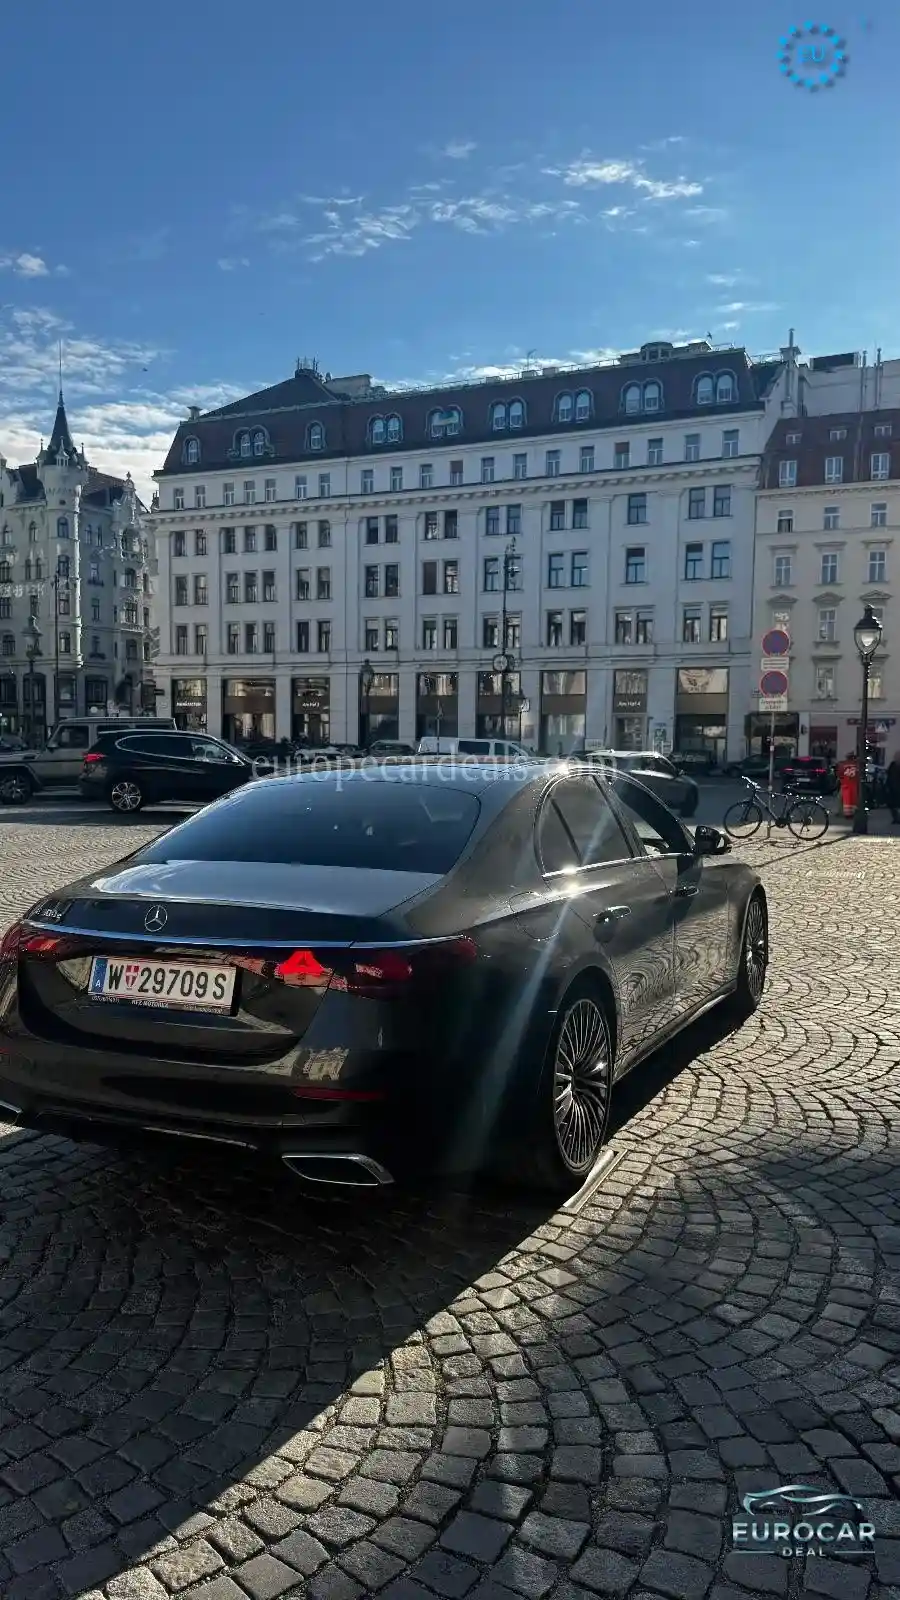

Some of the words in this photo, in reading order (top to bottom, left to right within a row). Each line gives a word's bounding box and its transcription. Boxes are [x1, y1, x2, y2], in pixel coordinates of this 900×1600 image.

[108, 964, 124, 990] W
[138, 967, 209, 999] 29709
[212, 973, 227, 1000] S
